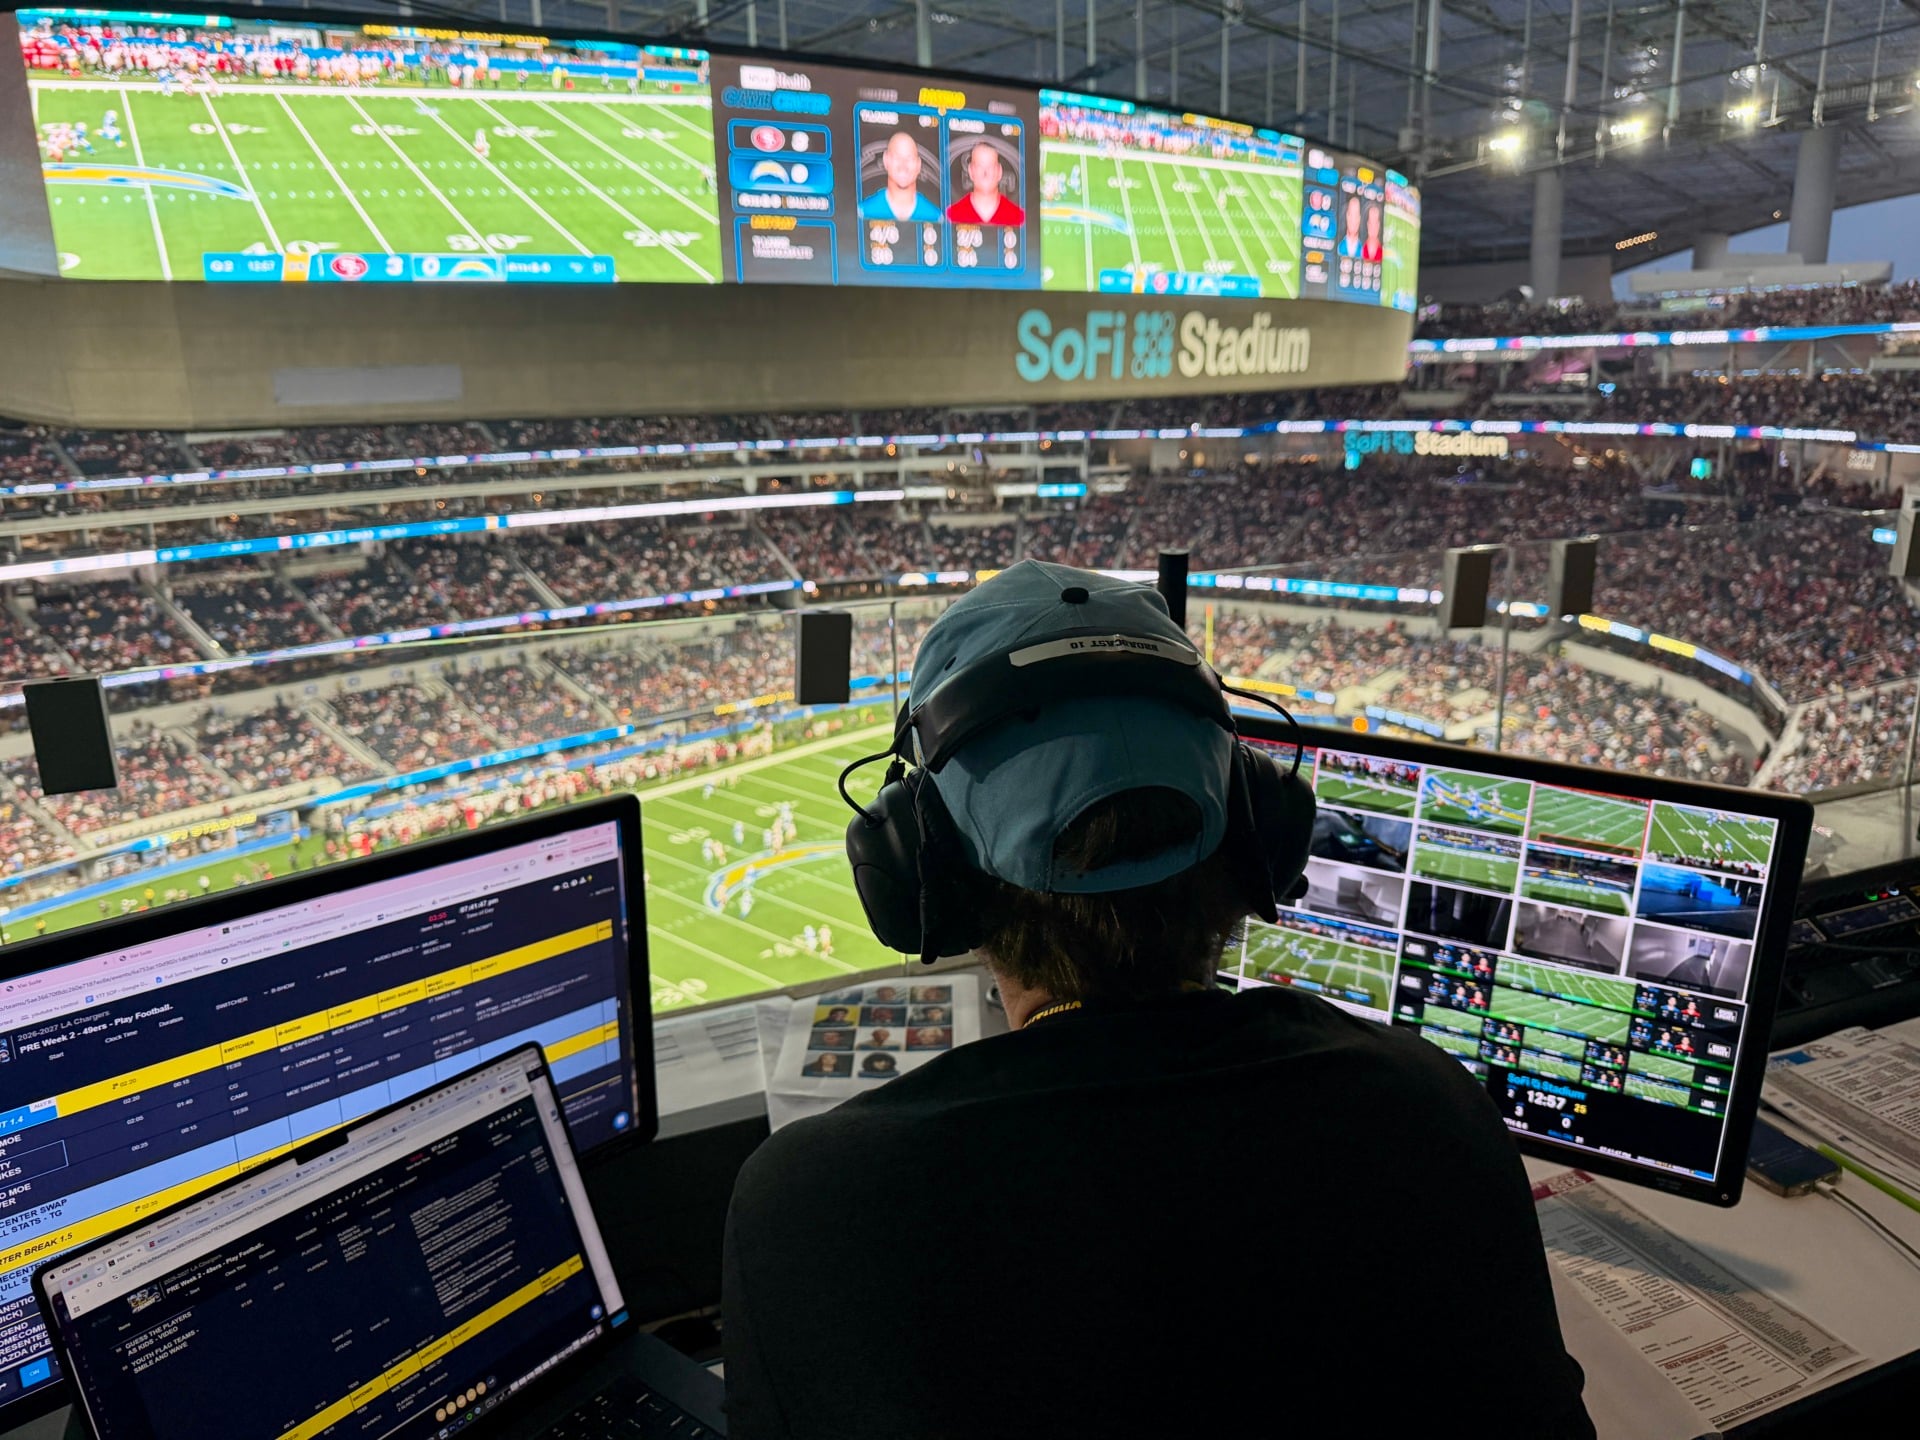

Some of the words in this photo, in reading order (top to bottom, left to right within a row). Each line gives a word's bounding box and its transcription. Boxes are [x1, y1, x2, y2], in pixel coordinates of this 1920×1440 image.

[385, 257, 404, 276] 3
[422, 255, 440, 276] 0
[1016, 308, 1126, 382] SoFi
[1178, 310, 1310, 378] Stadium
[1414, 431, 1508, 456] Stadium
[216, 996, 248, 1010] SWITCHER
[17, 1024, 58, 1042] 2026-2027
[61, 1020, 73, 1030] LA
[74, 1010, 110, 1026] Chargers
[159, 1016, 184, 1028] Duration
[19, 1042, 41, 1054] PRE
[41, 1034, 68, 1049] Week
[69, 1031, 76, 1040] 2
[82, 1022, 108, 1036] 49ers
[114, 1015, 133, 1028] Play
[105, 1034, 123, 1044] Clock
[123, 1029, 139, 1039] Time
[49, 1051, 65, 1061] Start
[224, 1040, 255, 1054] SWITCHER
[1507, 1072, 1530, 1086] SoFi
[1542, 1081, 1587, 1101] Stadium
[1527, 1090, 1567, 1110] 12:57
[10, 1116, 24, 1126] 1.4
[1515, 1105, 1524, 1117] 3
[1561, 1117, 1571, 1129] 0
[0, 1135, 21, 1148] MOE
[9, 1183, 32, 1196] MOE
[40, 1199, 68, 1214] SWAP
[11, 1217, 41, 1233] STATS
[49, 1209, 62, 1219] TG
[24, 1238, 58, 1256] BREAK
[60, 1232, 73, 1242] 1.5
[62, 1262, 82, 1274] Chrome
[118, 1240, 129, 1248] View
[166, 1283, 180, 1294] PRE
[180, 1276, 197, 1287] Week
[226, 1255, 239, 1266] Play
[125, 1334, 149, 1350] GUESS
[149, 1326, 162, 1338] THE
[162, 1311, 192, 1330] PLAYERS
[128, 1348, 138, 1356] AS
[138, 1338, 154, 1351] KIDS
[158, 1326, 178, 1340] VIDEO
[131, 1351, 155, 1368] YOUTH
[155, 1342, 173, 1356] FLAG
[173, 1331, 196, 1347] TEAMS
[133, 1360, 154, 1374] SMILE
[155, 1352, 169, 1363] AND
[169, 1341, 189, 1355] WAVE
